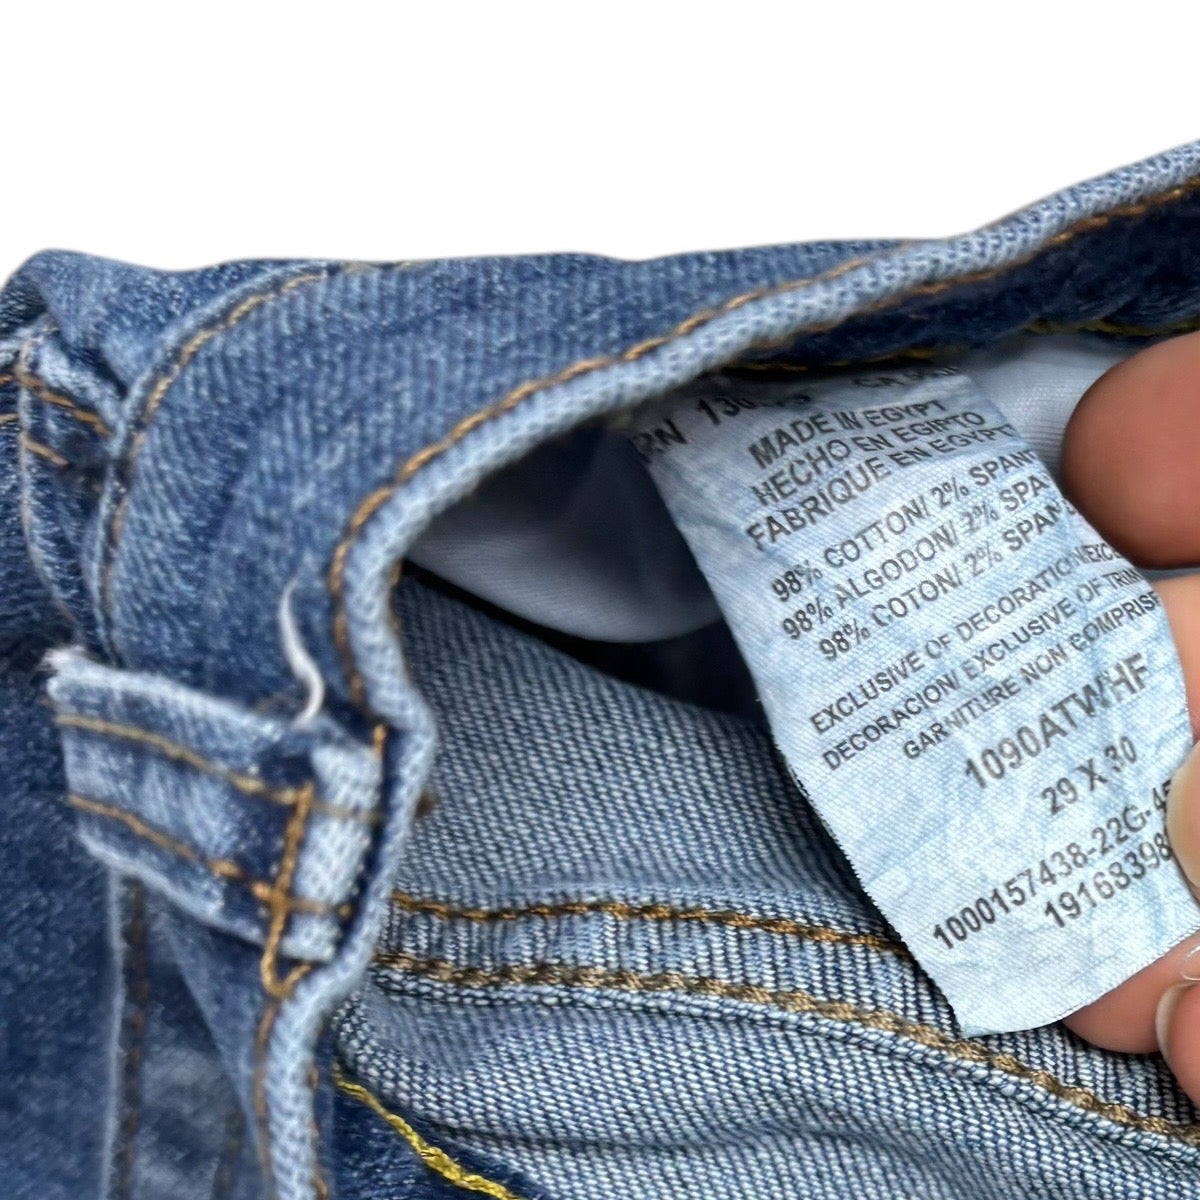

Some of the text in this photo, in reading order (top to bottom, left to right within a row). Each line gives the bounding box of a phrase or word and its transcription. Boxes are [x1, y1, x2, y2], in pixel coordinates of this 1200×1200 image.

[746, 424, 1017, 550] FABRIQUE EN EGYPT
[749, 399, 947, 469] MADE IN EGYPT
[751, 411, 986, 506] HECHO EN EGIPTO
[772, 559, 823, 602] 98%
[823, 495, 931, 568] COTTON/
[931, 477, 970, 508] 2%
[782, 596, 834, 640] 98%
[834, 520, 959, 609] ALGODON/
[960, 501, 999, 535] 2%
[819, 618, 871, 662] 98%
[872, 563, 962, 627] COTON/
[964, 540, 1003, 577] 2%
[810, 650, 925, 734] EXCLUSIVE
[924, 633, 951, 659] OF
[822, 669, 961, 770] DECORACION/
[961, 597, 1076, 681] EXCLUSIVE
[1075, 577, 1105, 603] OF
[903, 676, 1021, 760] GARNITURE
[1020, 644, 1069, 685] NON
[965, 652, 1148, 789] 1090ATWHF
[1041, 735, 1137, 815] 29 X 30
